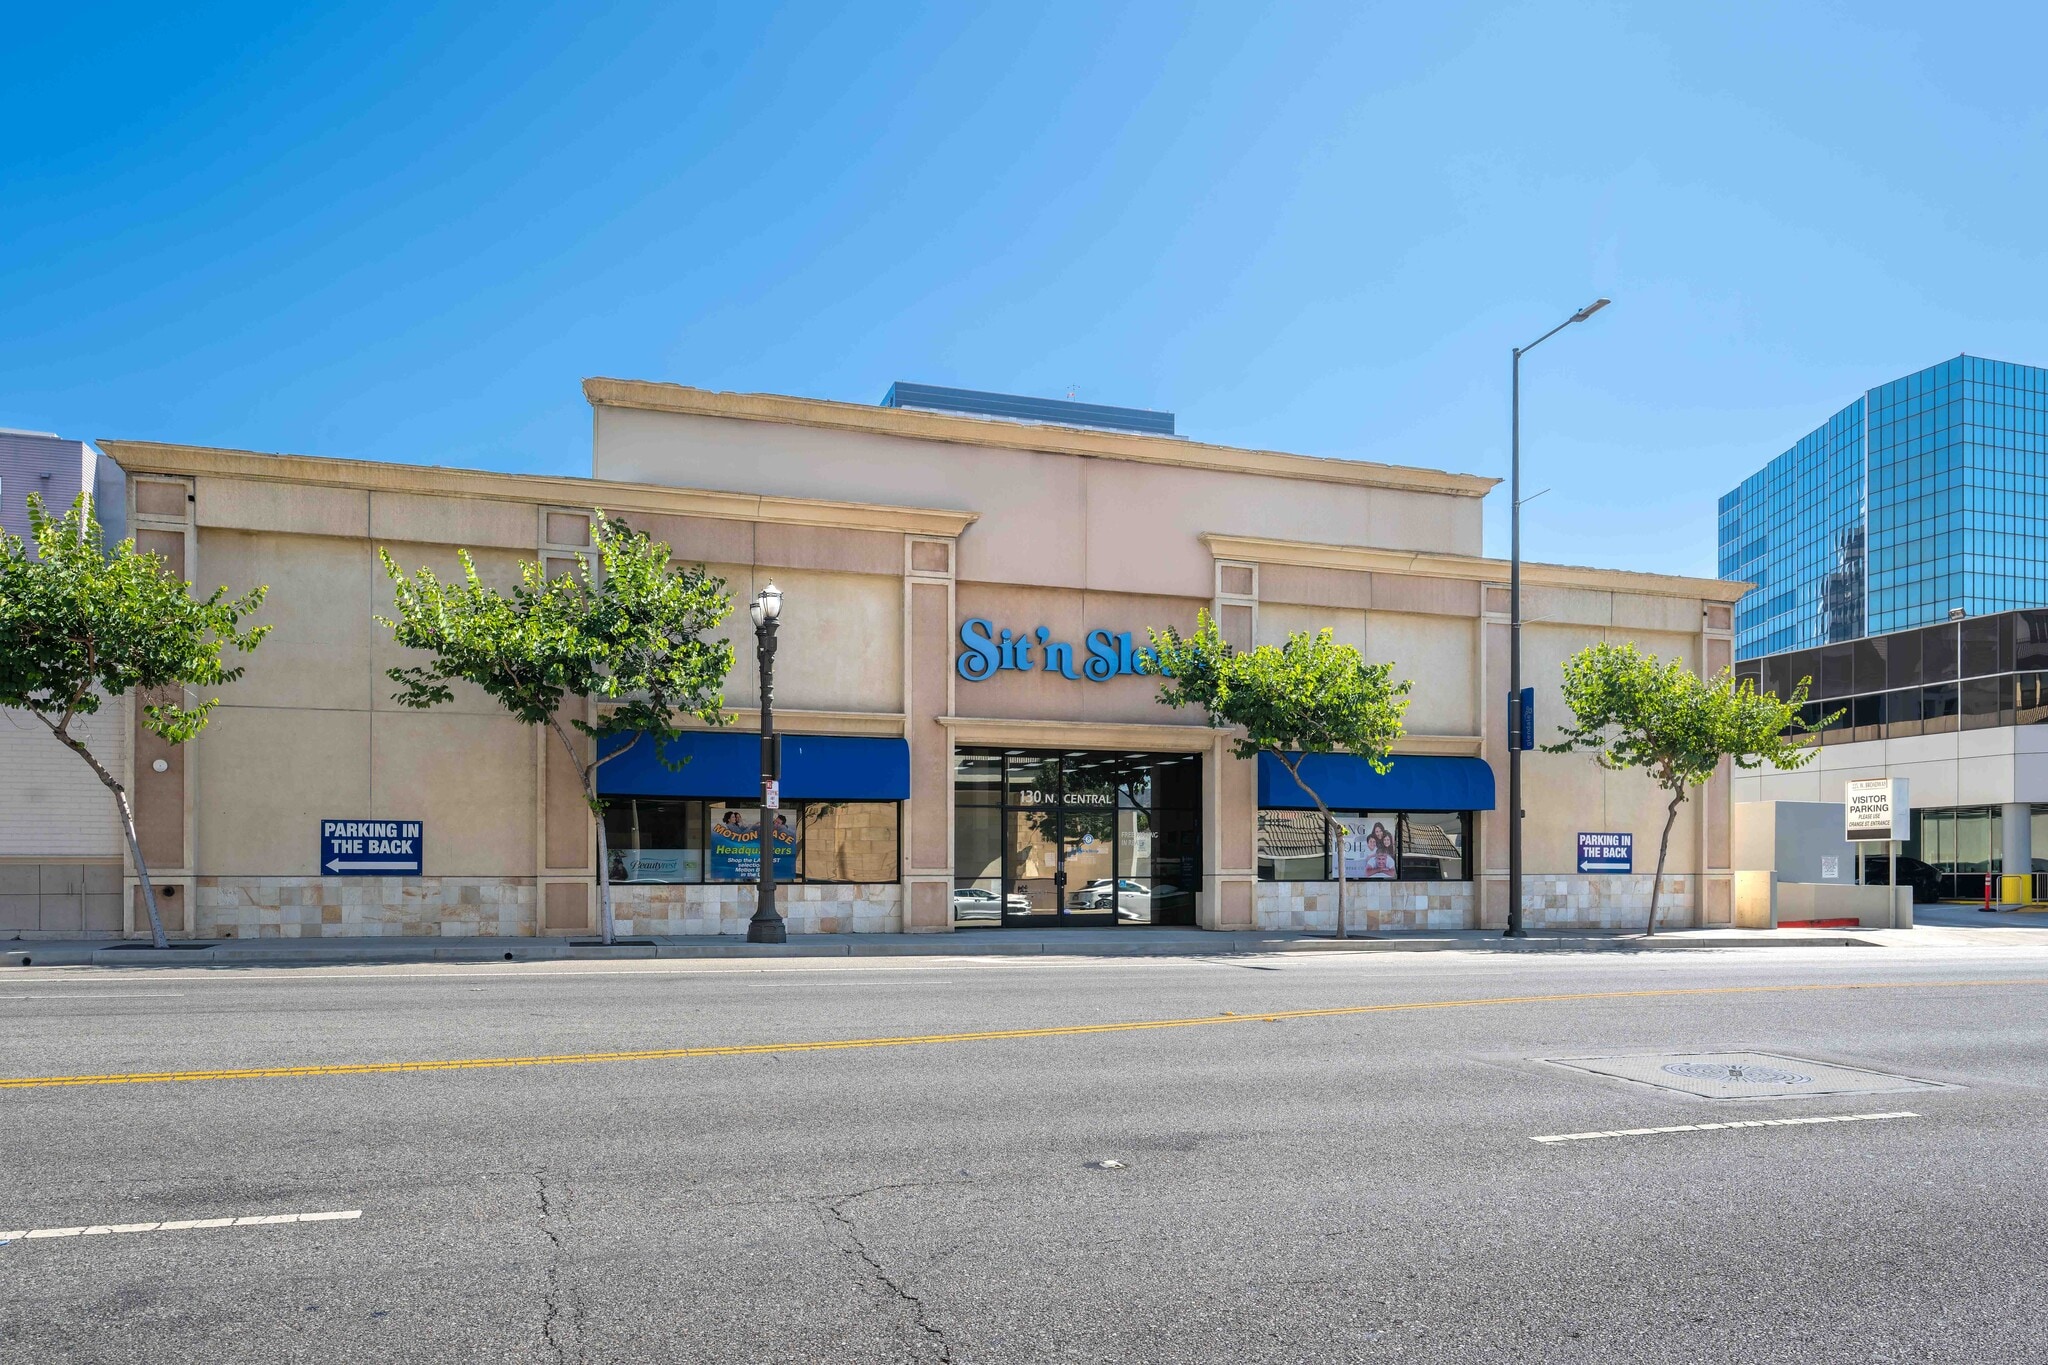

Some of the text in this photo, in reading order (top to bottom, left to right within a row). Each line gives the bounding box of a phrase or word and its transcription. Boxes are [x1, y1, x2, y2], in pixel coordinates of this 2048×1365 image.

[1083, 628, 1206, 683] Sle
[1019, 790, 1112, 805] 130 N. CENTRAL
[1852, 794, 1887, 804] VISITOR
[1850, 804, 1889, 813] PARKING
[324, 822, 419, 838] PARKING IN
[713, 823, 796, 845] MOTION ASE
[331, 839, 413, 854] THE BACK
[1579, 834, 1631, 846] PARKING IN
[1583, 846, 1628, 857] THE BACK
[629, 860, 678, 871] Beautyrest
